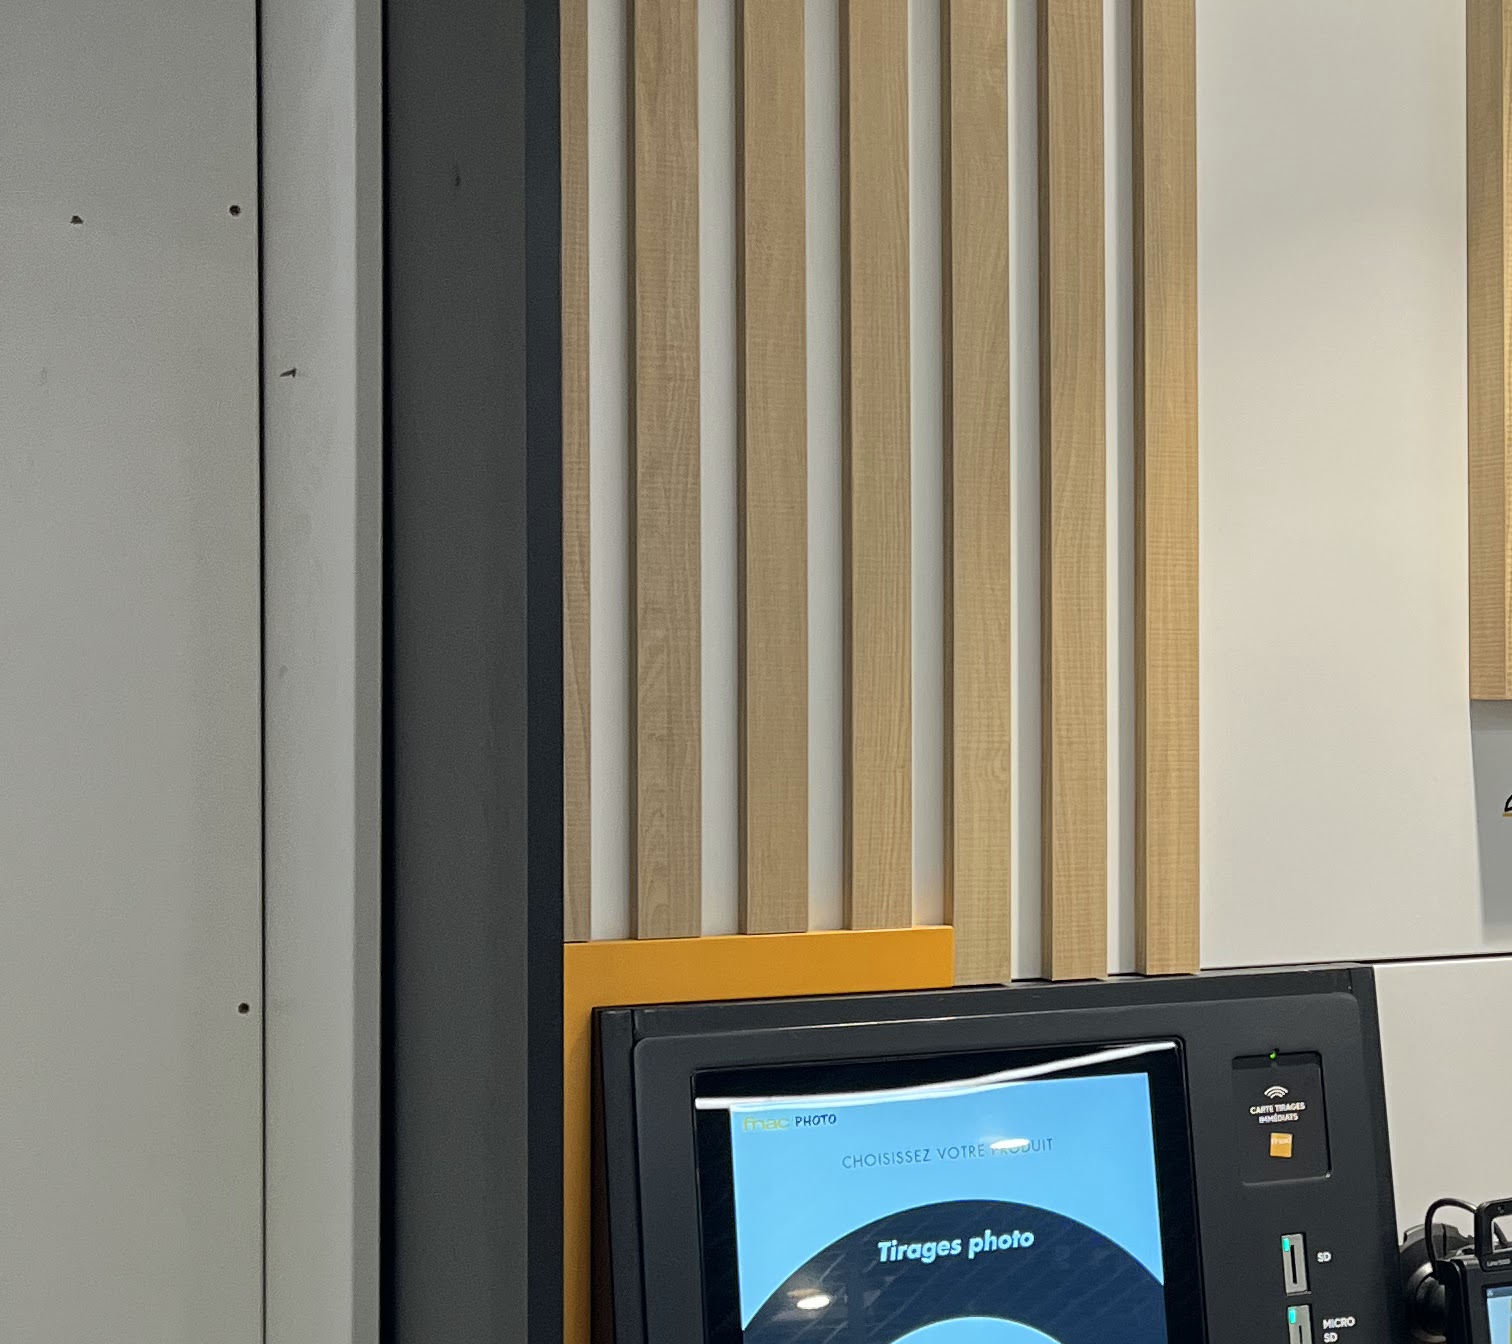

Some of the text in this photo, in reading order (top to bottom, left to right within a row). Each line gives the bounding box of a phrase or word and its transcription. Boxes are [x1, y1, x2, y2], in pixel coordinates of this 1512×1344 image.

[743, 1113, 837, 1132] fnac PHOTO
[842, 1148, 931, 1170] CHOISISSEZ
[937, 1143, 985, 1161] VOTRE
[878, 1229, 1035, 1264] Tirages photo
[1317, 1251, 1331, 1263] SD
[1323, 1316, 1356, 1330] MICRO
[1323, 1332, 1338, 1343] SD
